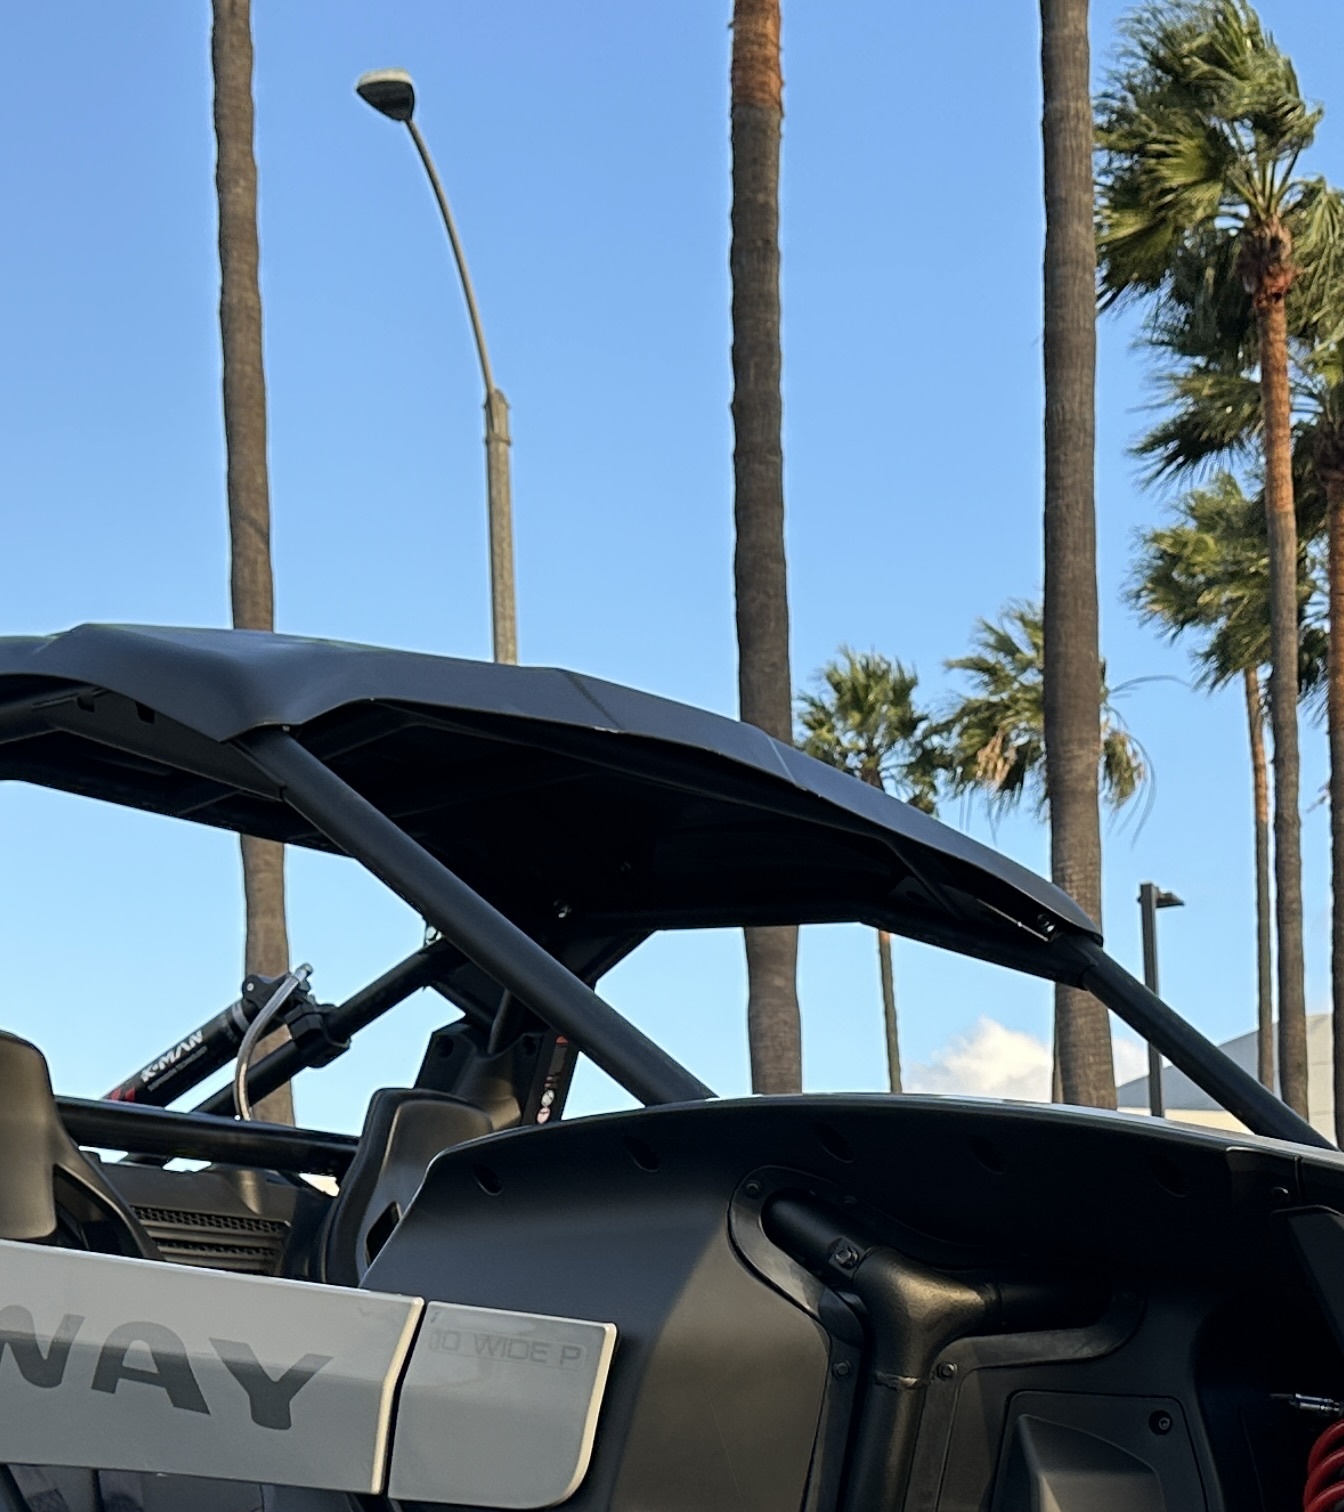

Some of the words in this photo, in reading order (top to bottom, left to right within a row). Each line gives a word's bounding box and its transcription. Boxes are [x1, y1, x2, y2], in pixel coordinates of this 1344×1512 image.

[140, 1029, 204, 1083] K-MAN
[474, 1332, 552, 1364] WIDE
[559, 1344, 583, 1366] P
